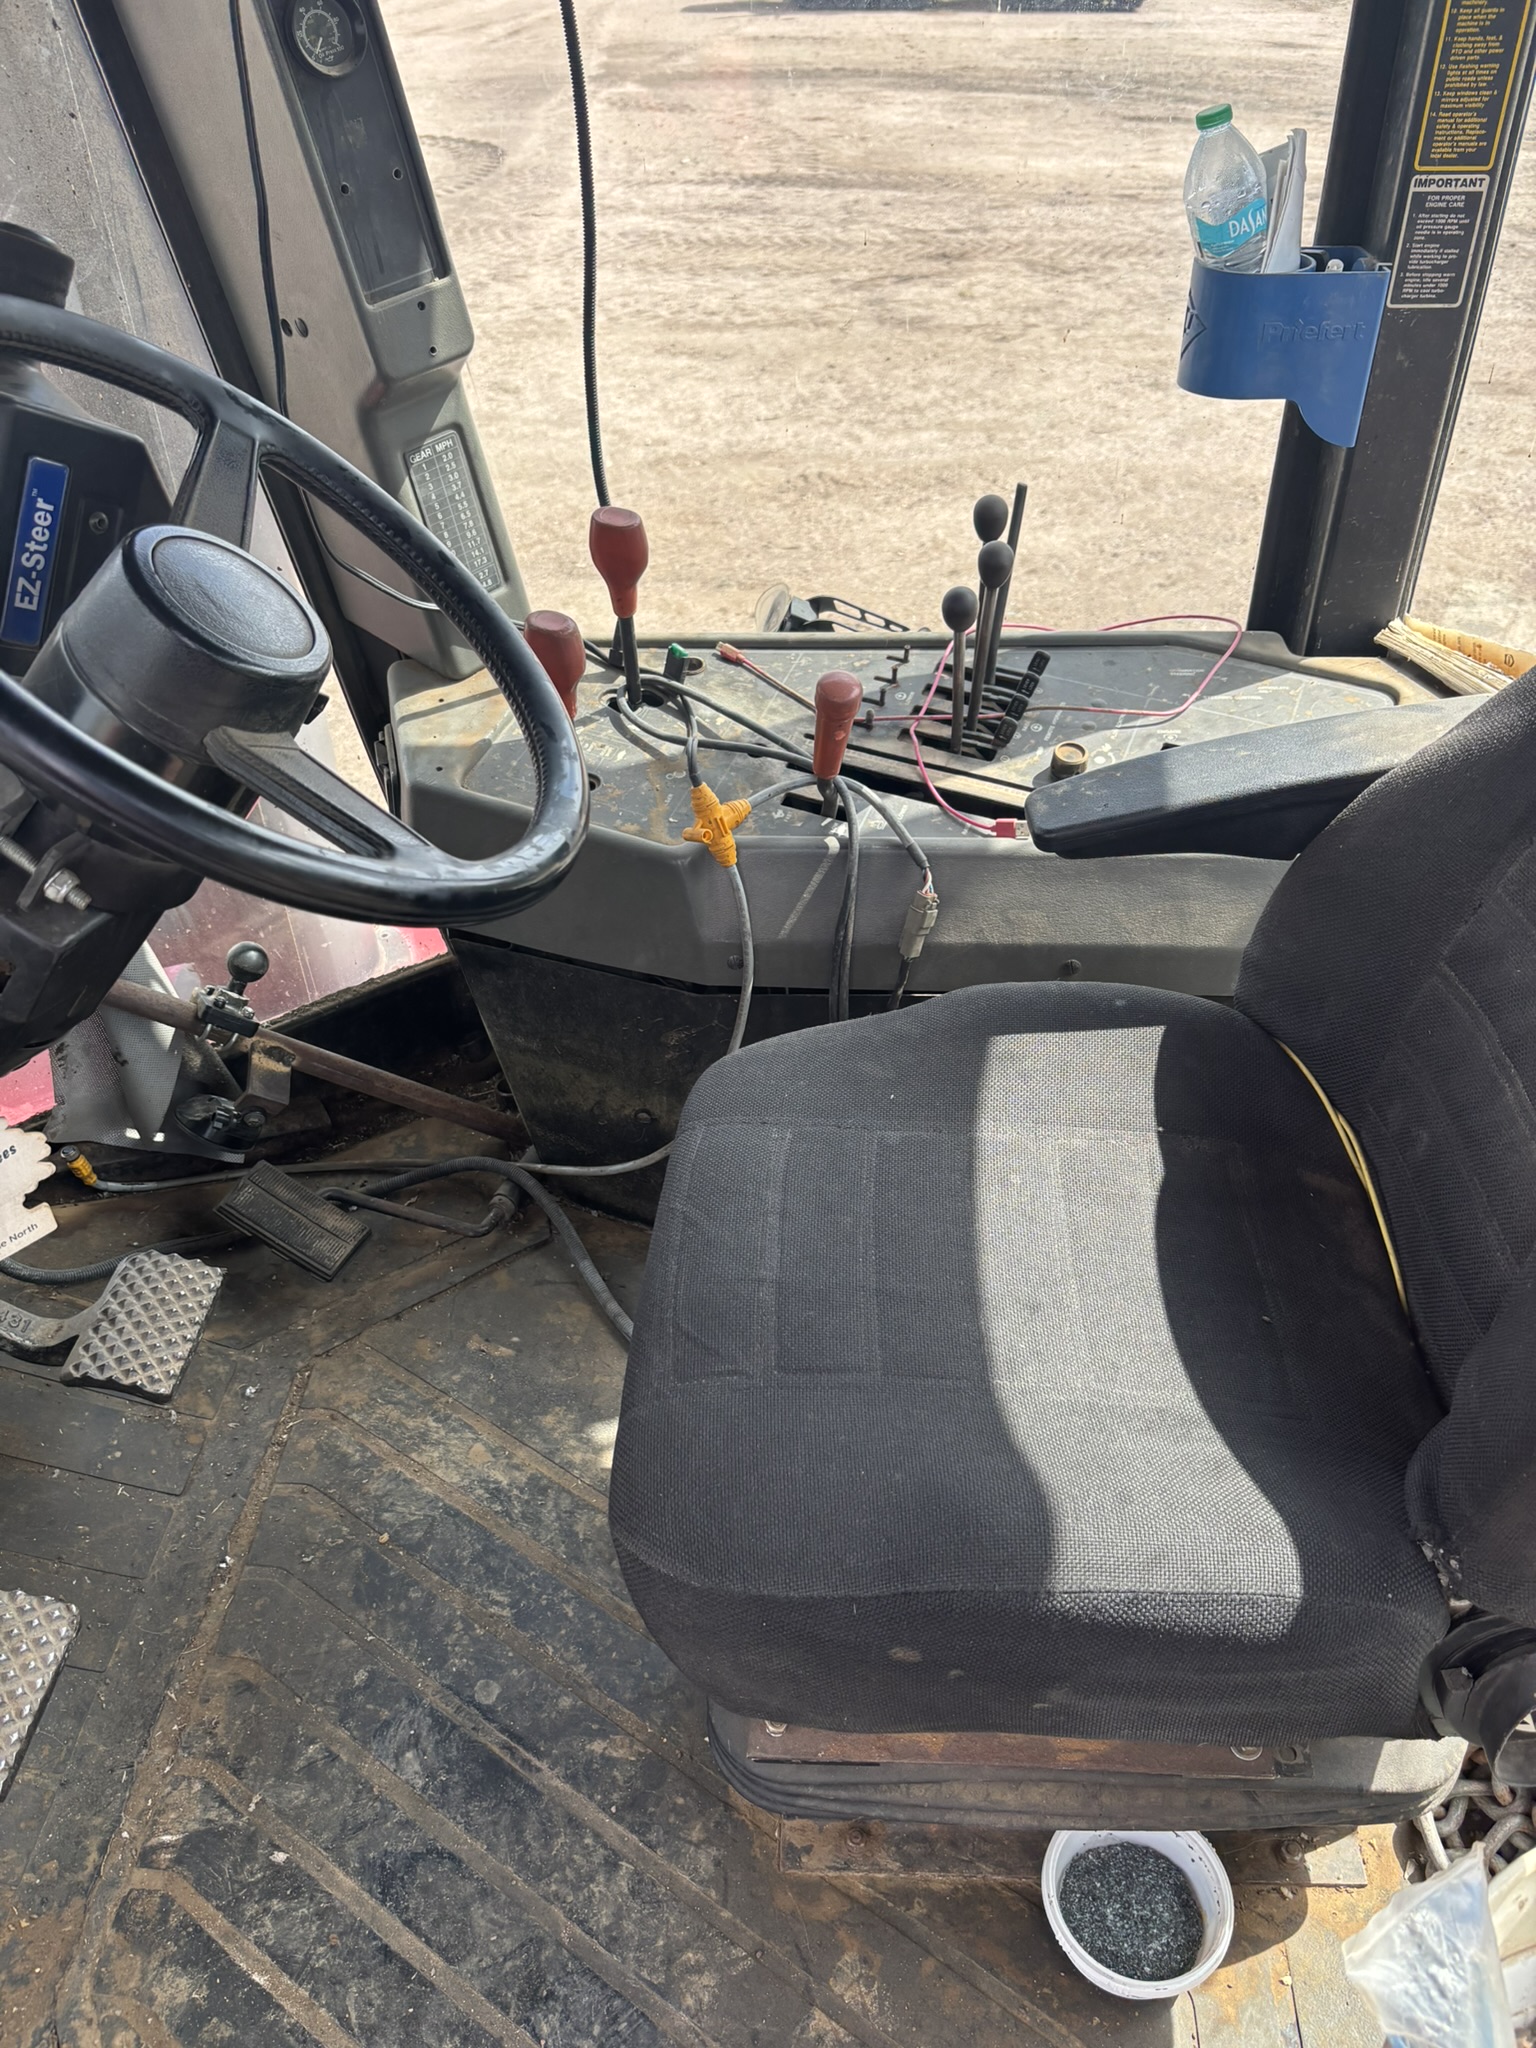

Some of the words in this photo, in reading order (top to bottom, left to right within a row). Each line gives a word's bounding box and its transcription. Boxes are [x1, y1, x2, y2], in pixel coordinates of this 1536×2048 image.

[1413, 177, 1486, 188] IMPORTANT
[1263, 321, 1366, 344] Priefert
[410, 448, 432, 463] GEAR
[435, 438, 453, 452] MPH
[442, 452, 453, 462] 2.0
[445, 462, 456, 471] 2.5
[452, 481, 461, 491] 3.7
[455, 491, 465, 500] 4.4
[458, 501, 468, 510] 5.5
[461, 510, 471, 520] 6.5
[463, 520, 474, 529] 7.8
[466, 528, 477, 538] 9.6
[468, 537, 480, 548] 11.7
[14, 497, 55, 612] EZ-Steer
[471, 547, 484, 558] 14.1
[474, 556, 487, 567] 17.3
[479, 569, 488, 579] 2.7
[9, 1223, 39, 1243] North
